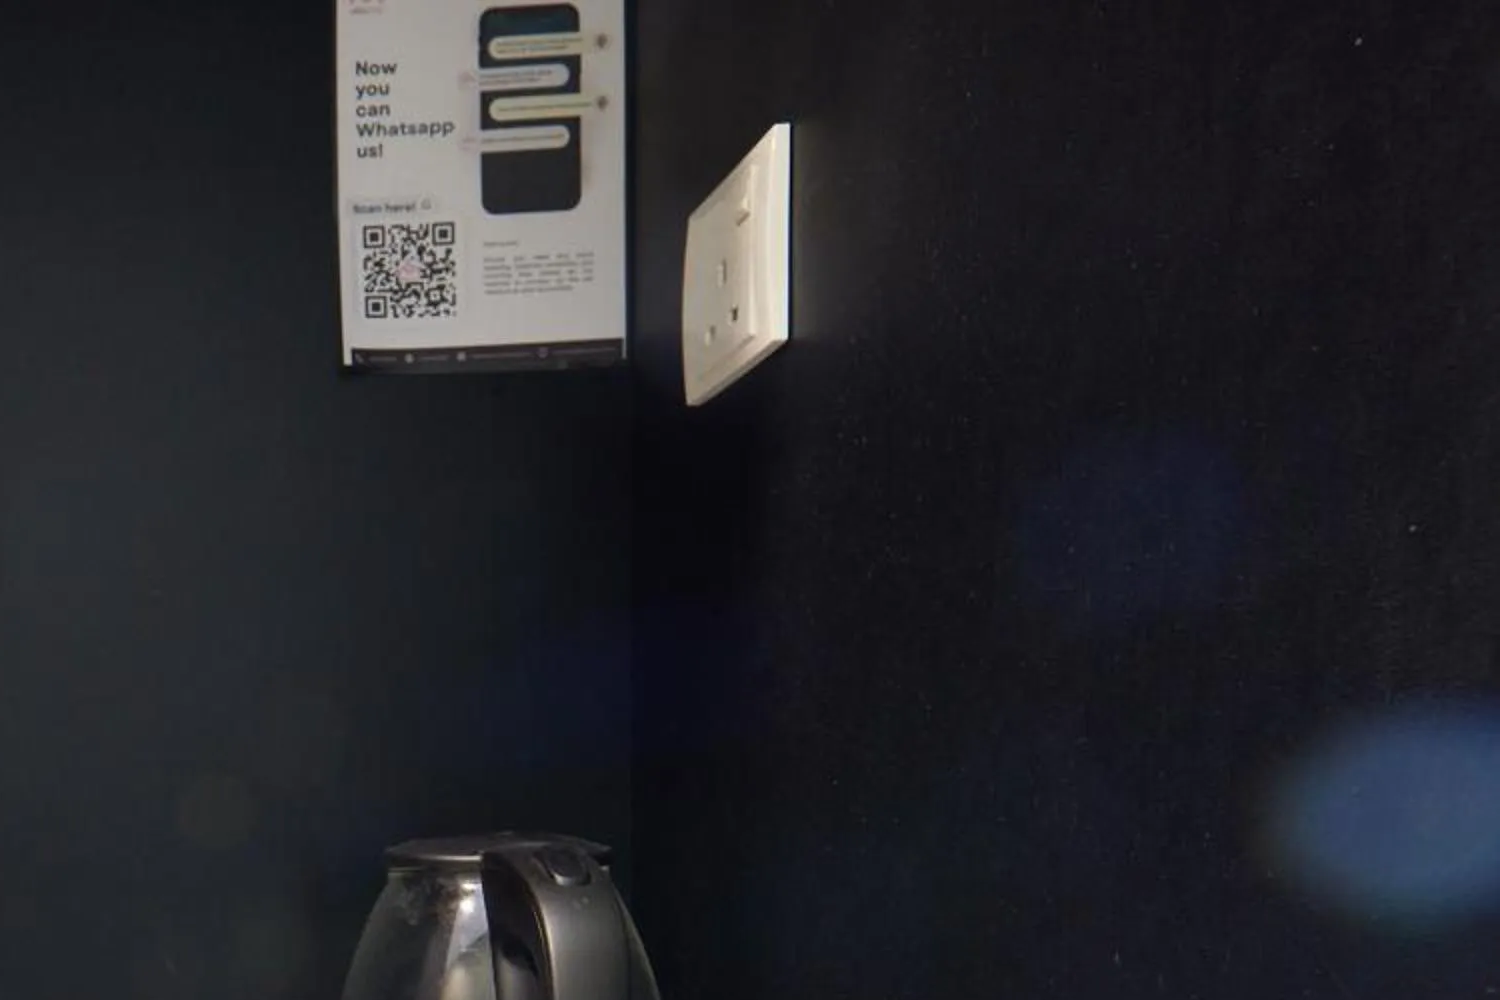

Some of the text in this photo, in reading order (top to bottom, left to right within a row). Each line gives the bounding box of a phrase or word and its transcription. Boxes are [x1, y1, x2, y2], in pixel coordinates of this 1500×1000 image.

[355, 61, 398, 76] Now
[355, 84, 391, 99] you
[355, 103, 391, 117] can
[356, 121, 455, 138] Whatsapp
[357, 144, 384, 159] us!
